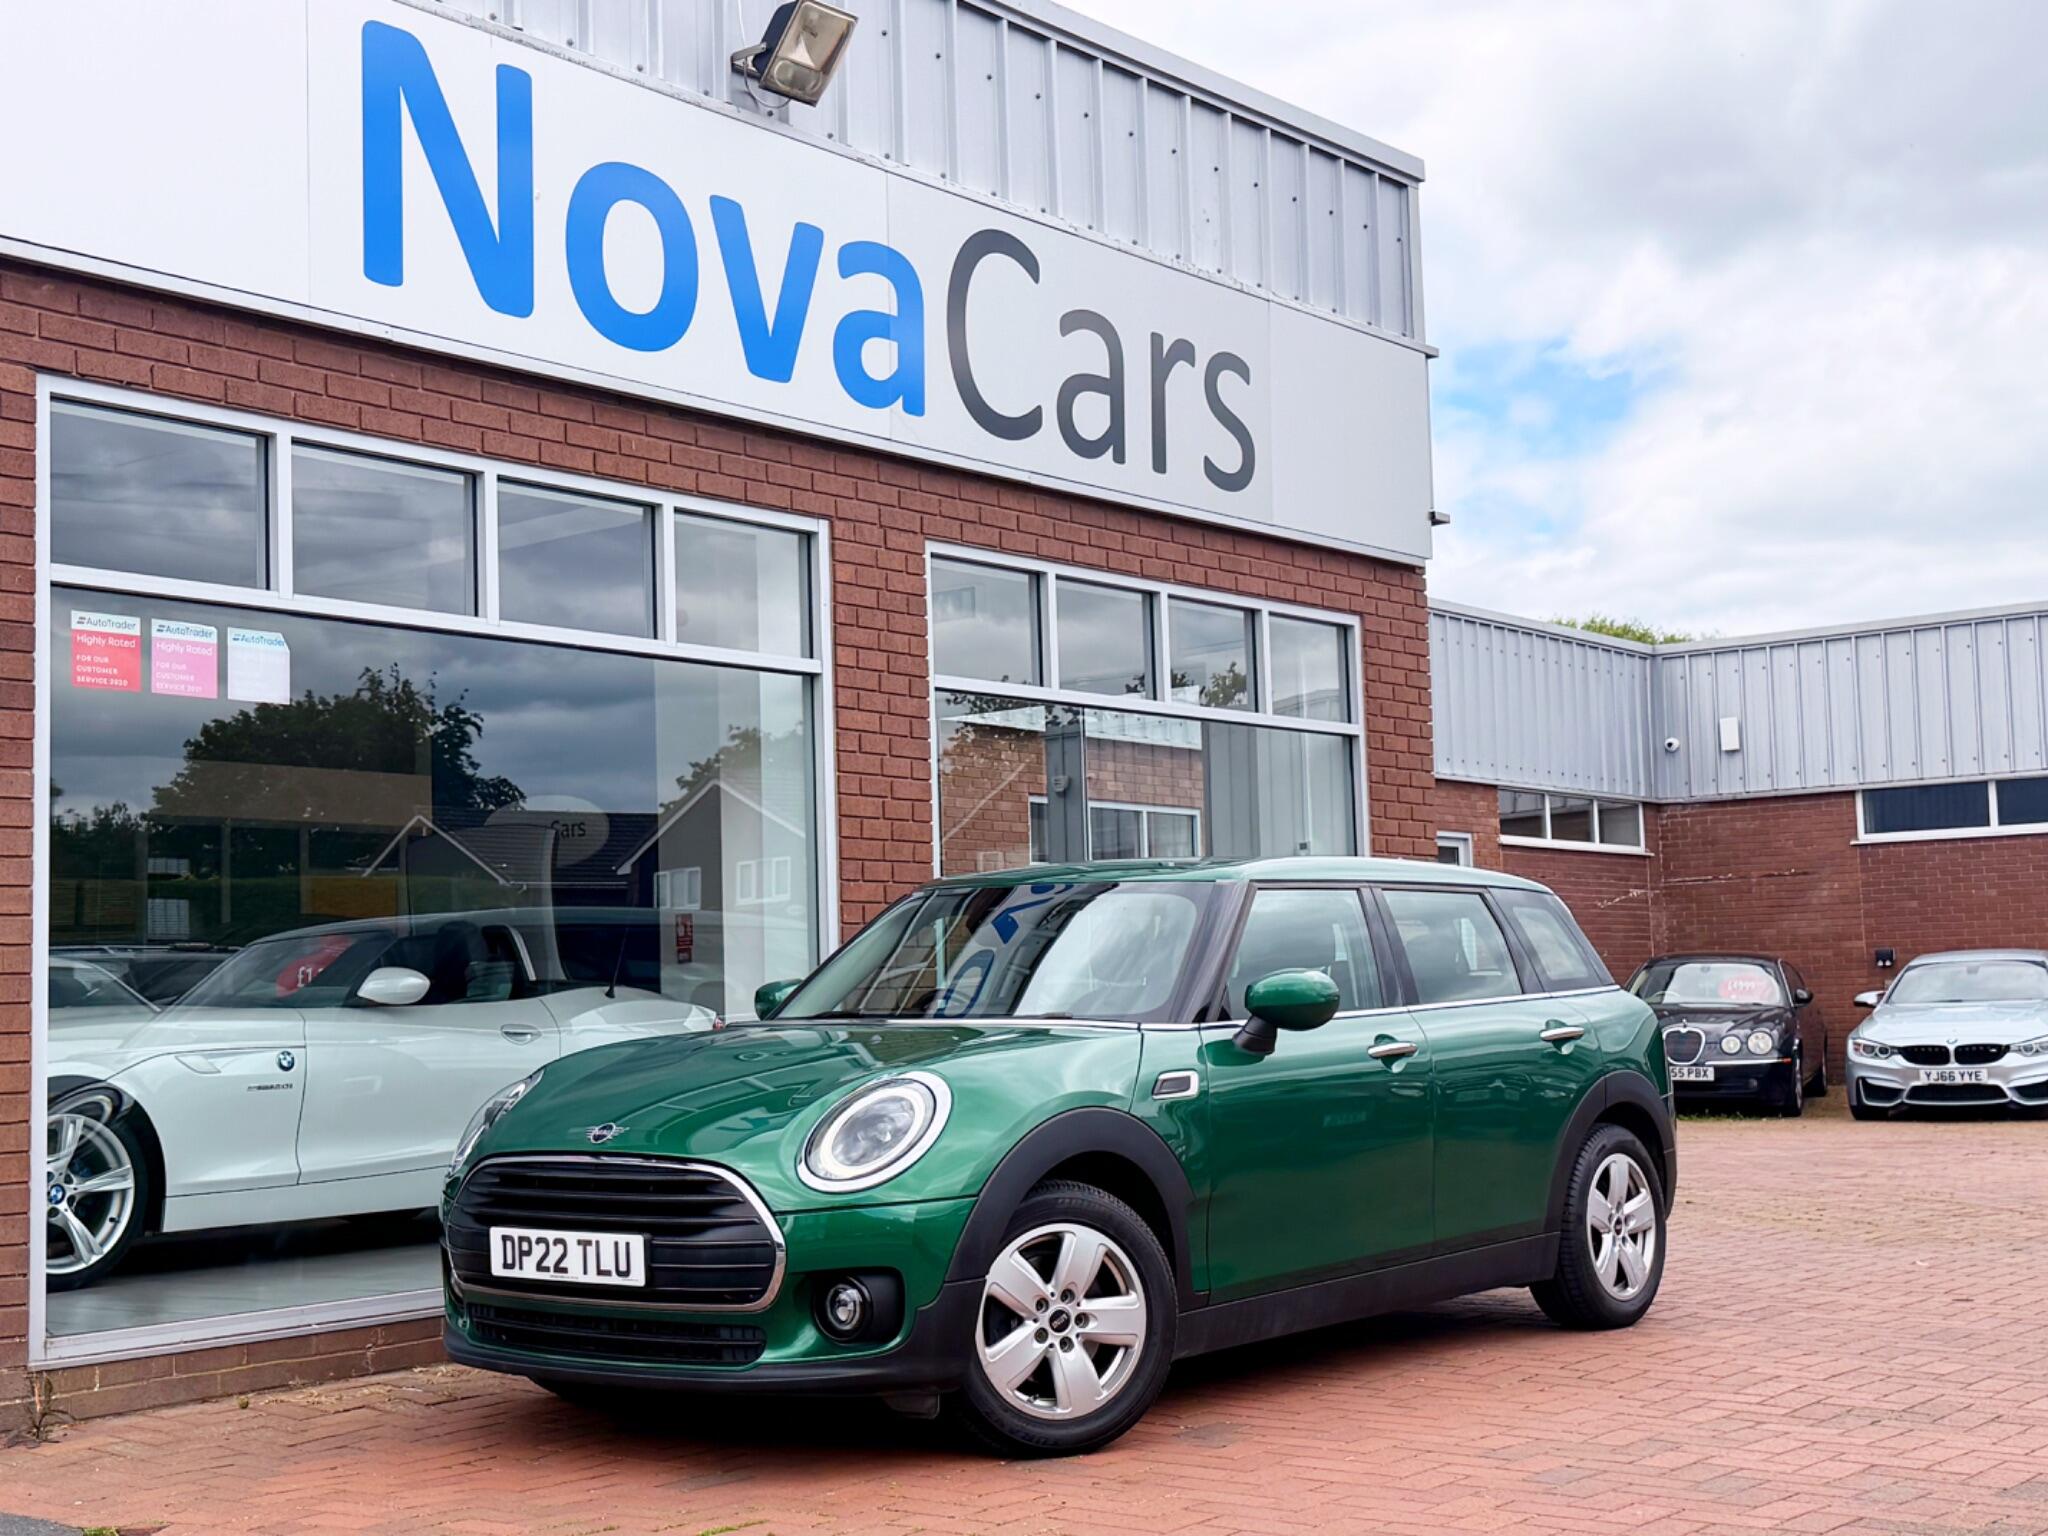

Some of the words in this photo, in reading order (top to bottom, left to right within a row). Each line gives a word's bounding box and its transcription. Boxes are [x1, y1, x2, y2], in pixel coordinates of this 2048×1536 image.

[86, 616, 136, 631] AutoTrader
[166, 625, 213, 638] AutoTrader
[76, 633, 106, 648] Highly
[108, 636, 136, 648] Rated
[156, 641, 184, 655] Highly
[185, 644, 213, 656] Rated
[76, 665, 118, 675] CUSTOMER
[1925, 1071, 1956, 1081] YJ66
[1959, 1071, 1982, 1081] YYE
[501, 1234, 569, 1275] DP22
[577, 1239, 631, 1279] TLU
